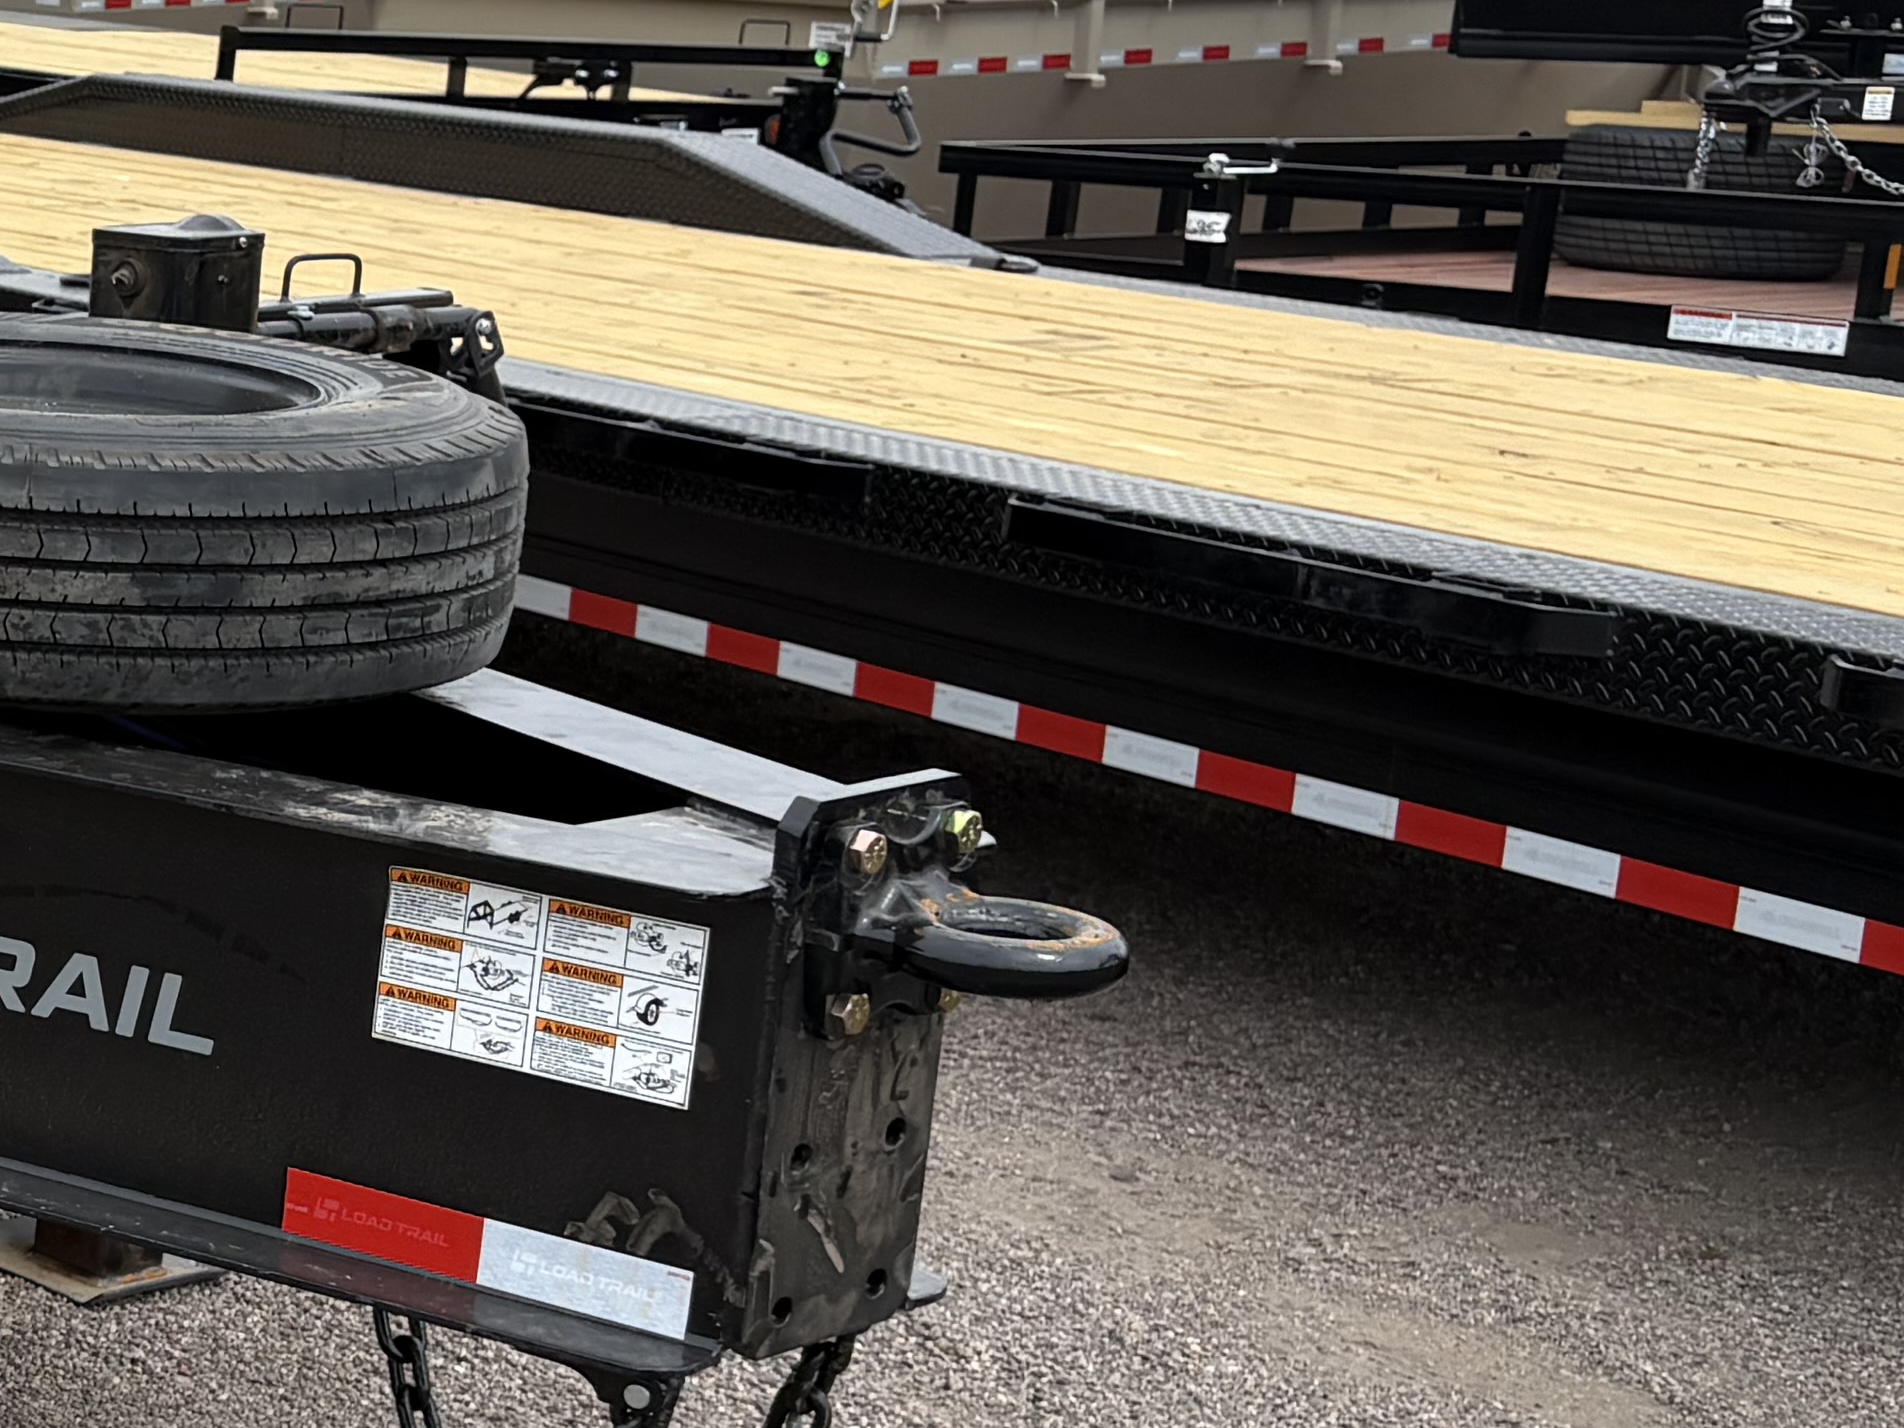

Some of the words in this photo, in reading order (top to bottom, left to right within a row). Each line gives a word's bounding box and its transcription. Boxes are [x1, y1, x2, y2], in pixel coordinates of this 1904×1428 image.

[410, 874, 463, 892] WARNING
[568, 905, 624, 926] WARNING
[404, 931, 456, 950] WARNING
[562, 964, 617, 985] WARNING
[398, 988, 449, 1009] WARNING
[555, 1024, 610, 1045] WARNING
[341, 1208, 394, 1231] LOAD
[393, 1219, 450, 1248] TRAIL
[538, 1261, 594, 1286] LOAD
[594, 1272, 661, 1305] TRAIL
